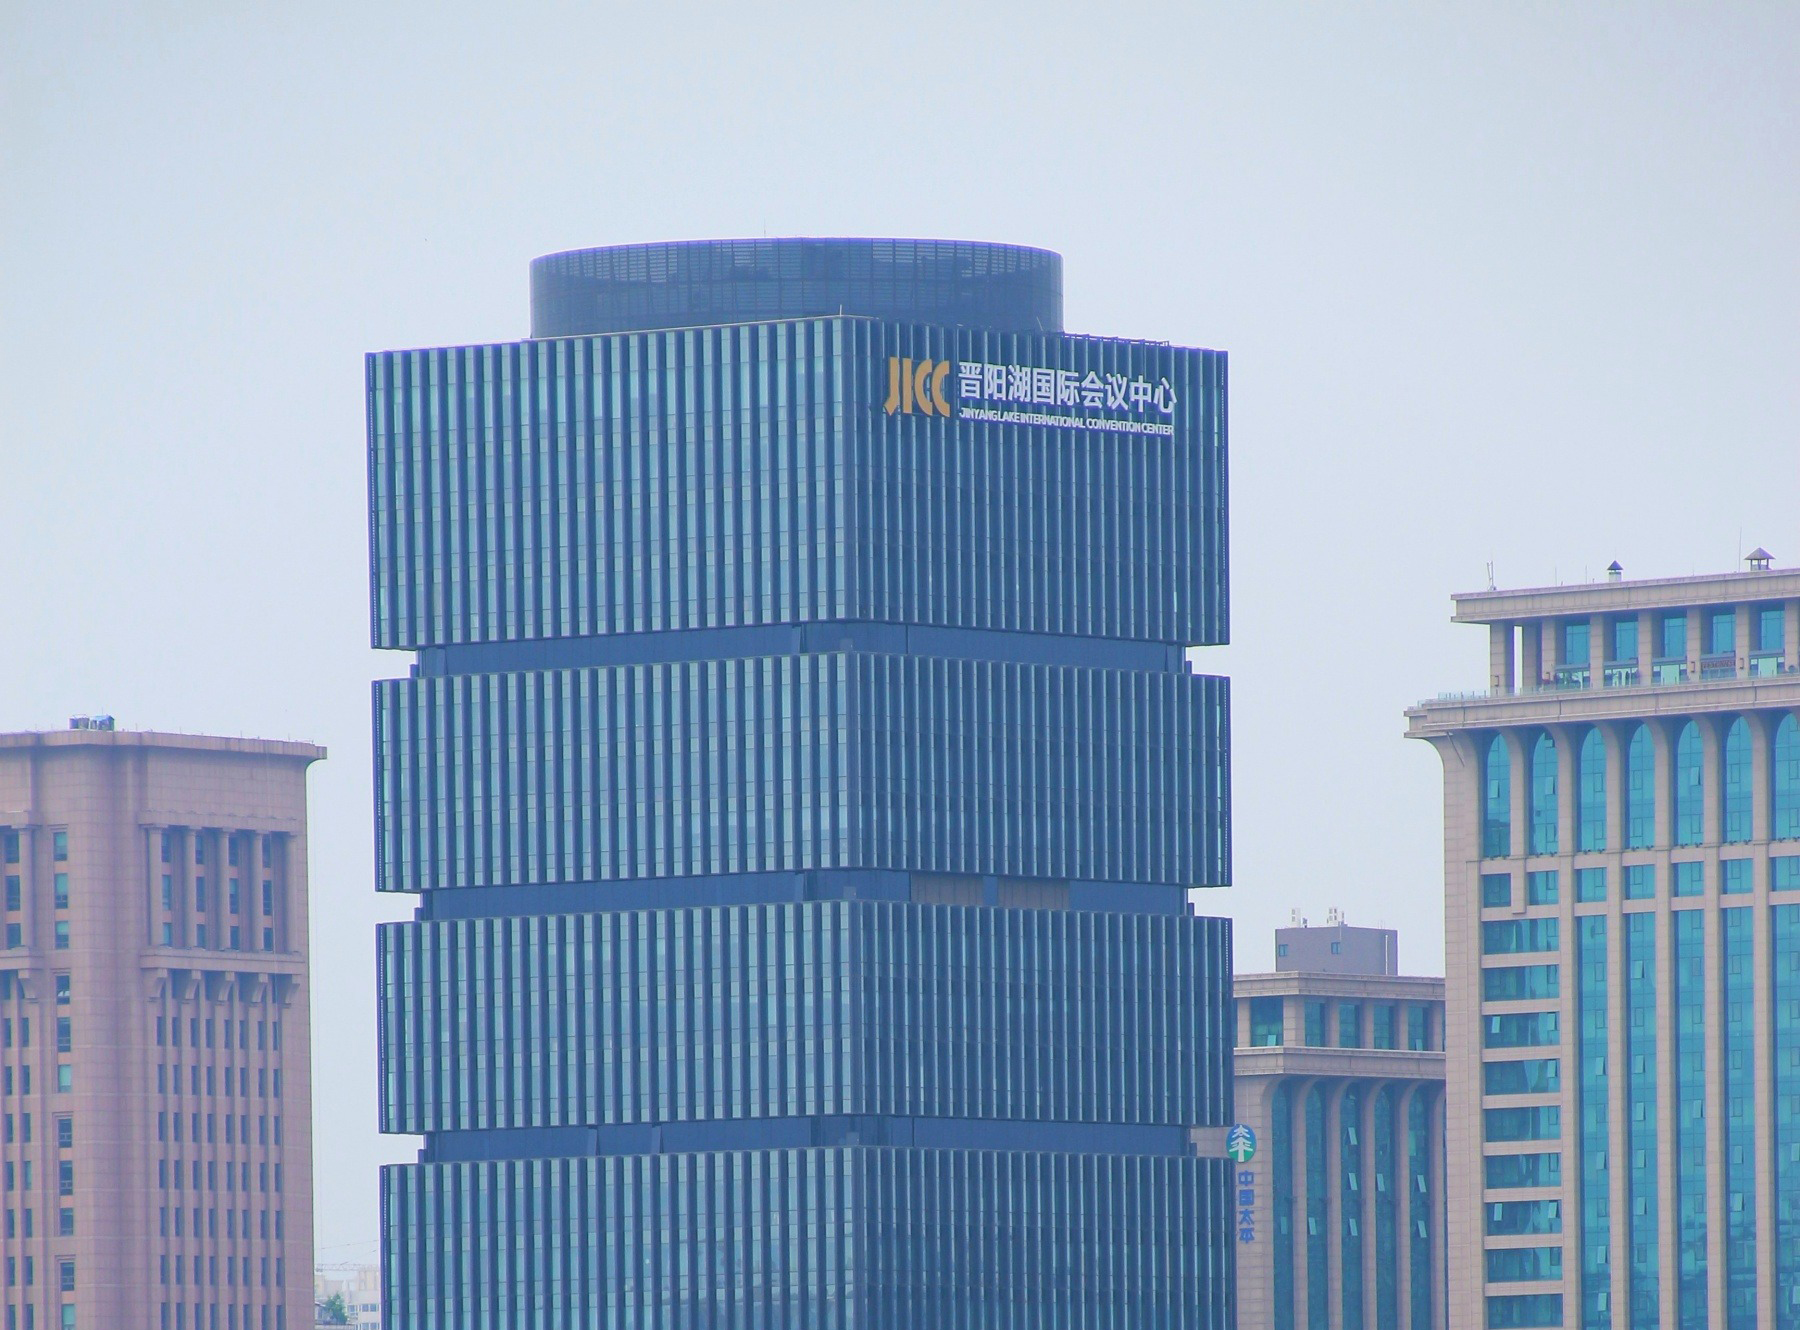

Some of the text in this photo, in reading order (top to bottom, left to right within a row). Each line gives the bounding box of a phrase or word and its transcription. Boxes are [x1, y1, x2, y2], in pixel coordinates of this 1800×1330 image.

[884, 356, 950, 417] JICC
[958, 361, 1177, 413] 晋阳湖国际会议中心
[959, 407, 1174, 436] JINYANG LAKE INTERNATIONAL CONVENTION CENTER
